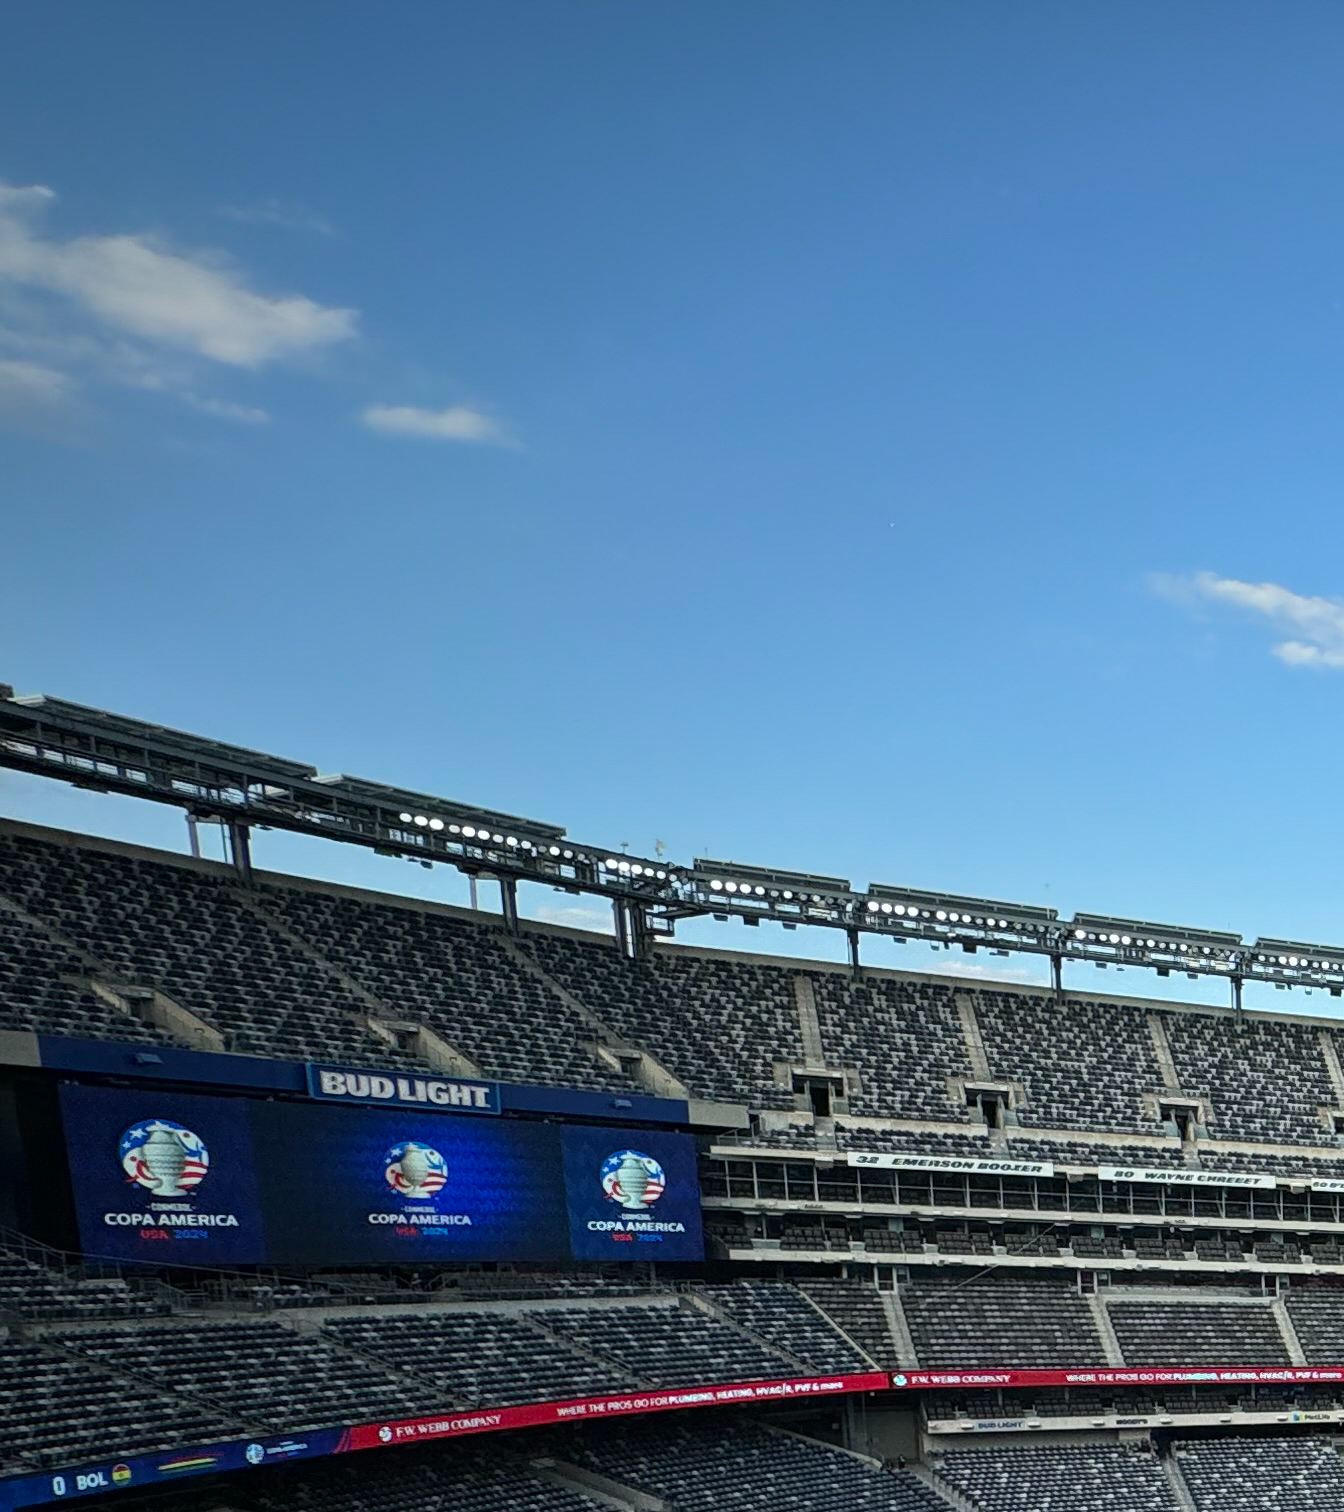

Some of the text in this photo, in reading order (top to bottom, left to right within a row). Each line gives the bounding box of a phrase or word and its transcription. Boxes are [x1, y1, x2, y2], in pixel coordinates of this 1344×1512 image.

[319, 1069, 492, 1108] BUD LIGHT
[856, 1156, 1043, 1172] 32 EMERSON BOOZER
[1145, 1172, 1194, 1181] WAYNE
[1197, 1175, 1262, 1185] CHREBET
[104, 1213, 239, 1227] COPA AMERICA
[368, 1214, 472, 1225] COPA AMERICA
[587, 1221, 685, 1232] COPA AMERICA
[962, 1375, 1011, 1383] COMPANY
[557, 1405, 587, 1415] WHERE
[589, 1403, 606, 1413] THE
[607, 1400, 633, 1410] PROS
[634, 1399, 648, 1408] GO
[650, 1398, 668, 1407] FOR
[417, 1421, 449, 1434] WEBB
[451, 1415, 501, 1429] COMPANY
[76, 1473, 108, 1490] BOL
